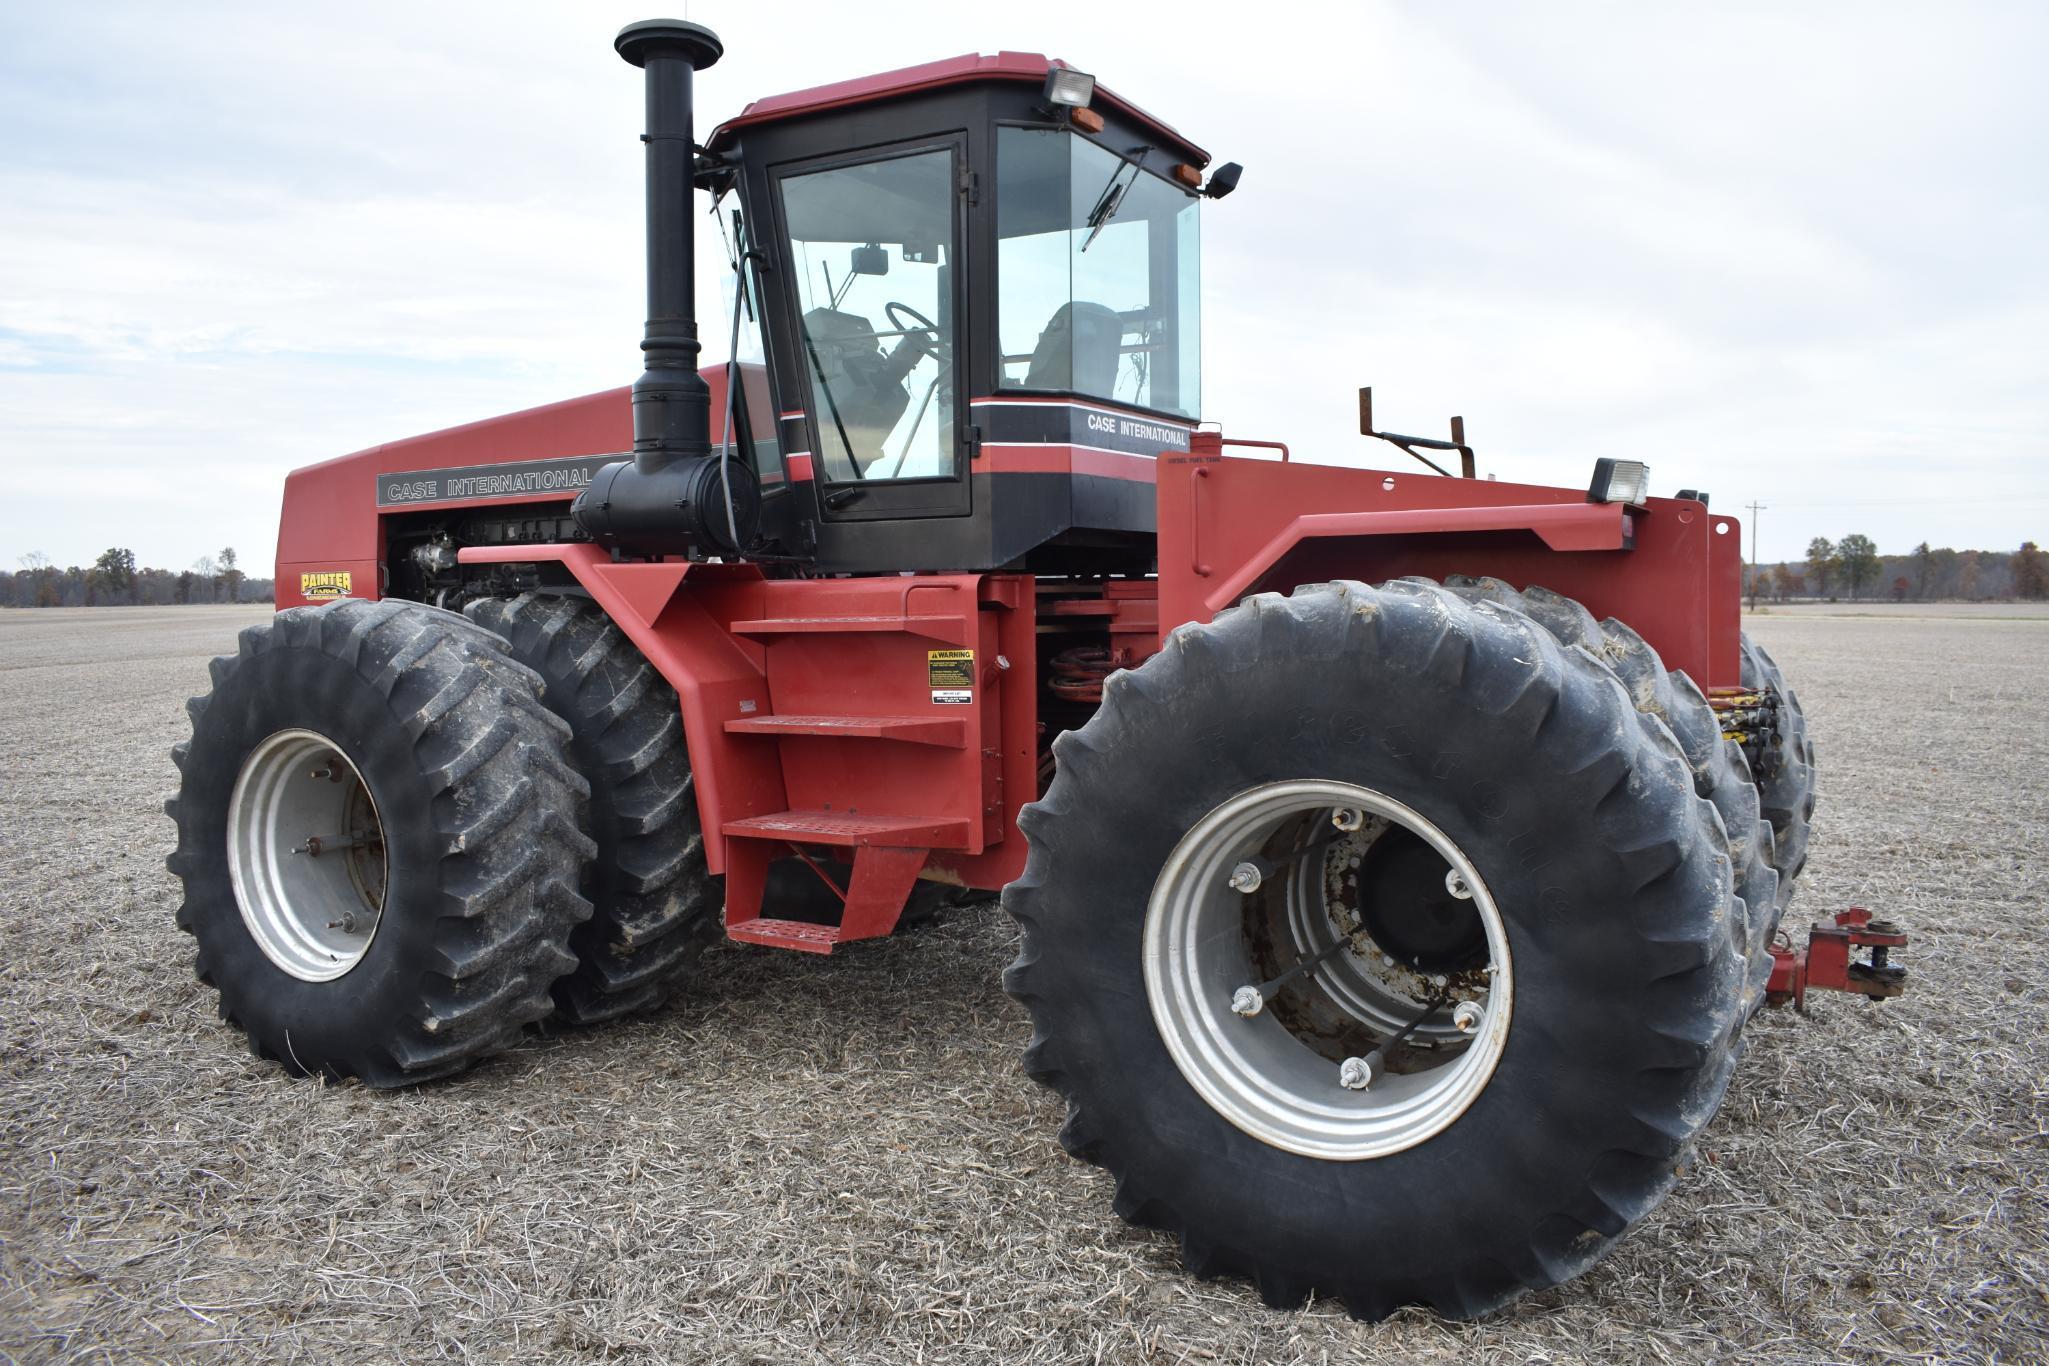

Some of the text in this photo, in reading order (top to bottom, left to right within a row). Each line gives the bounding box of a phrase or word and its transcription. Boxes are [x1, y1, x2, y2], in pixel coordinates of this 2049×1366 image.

[1087, 414, 1186, 446] CASE INTERNATIONAL
[388, 468, 593, 501] CASE INTERNATIONAL
[301, 572, 352, 593] PAINTER
